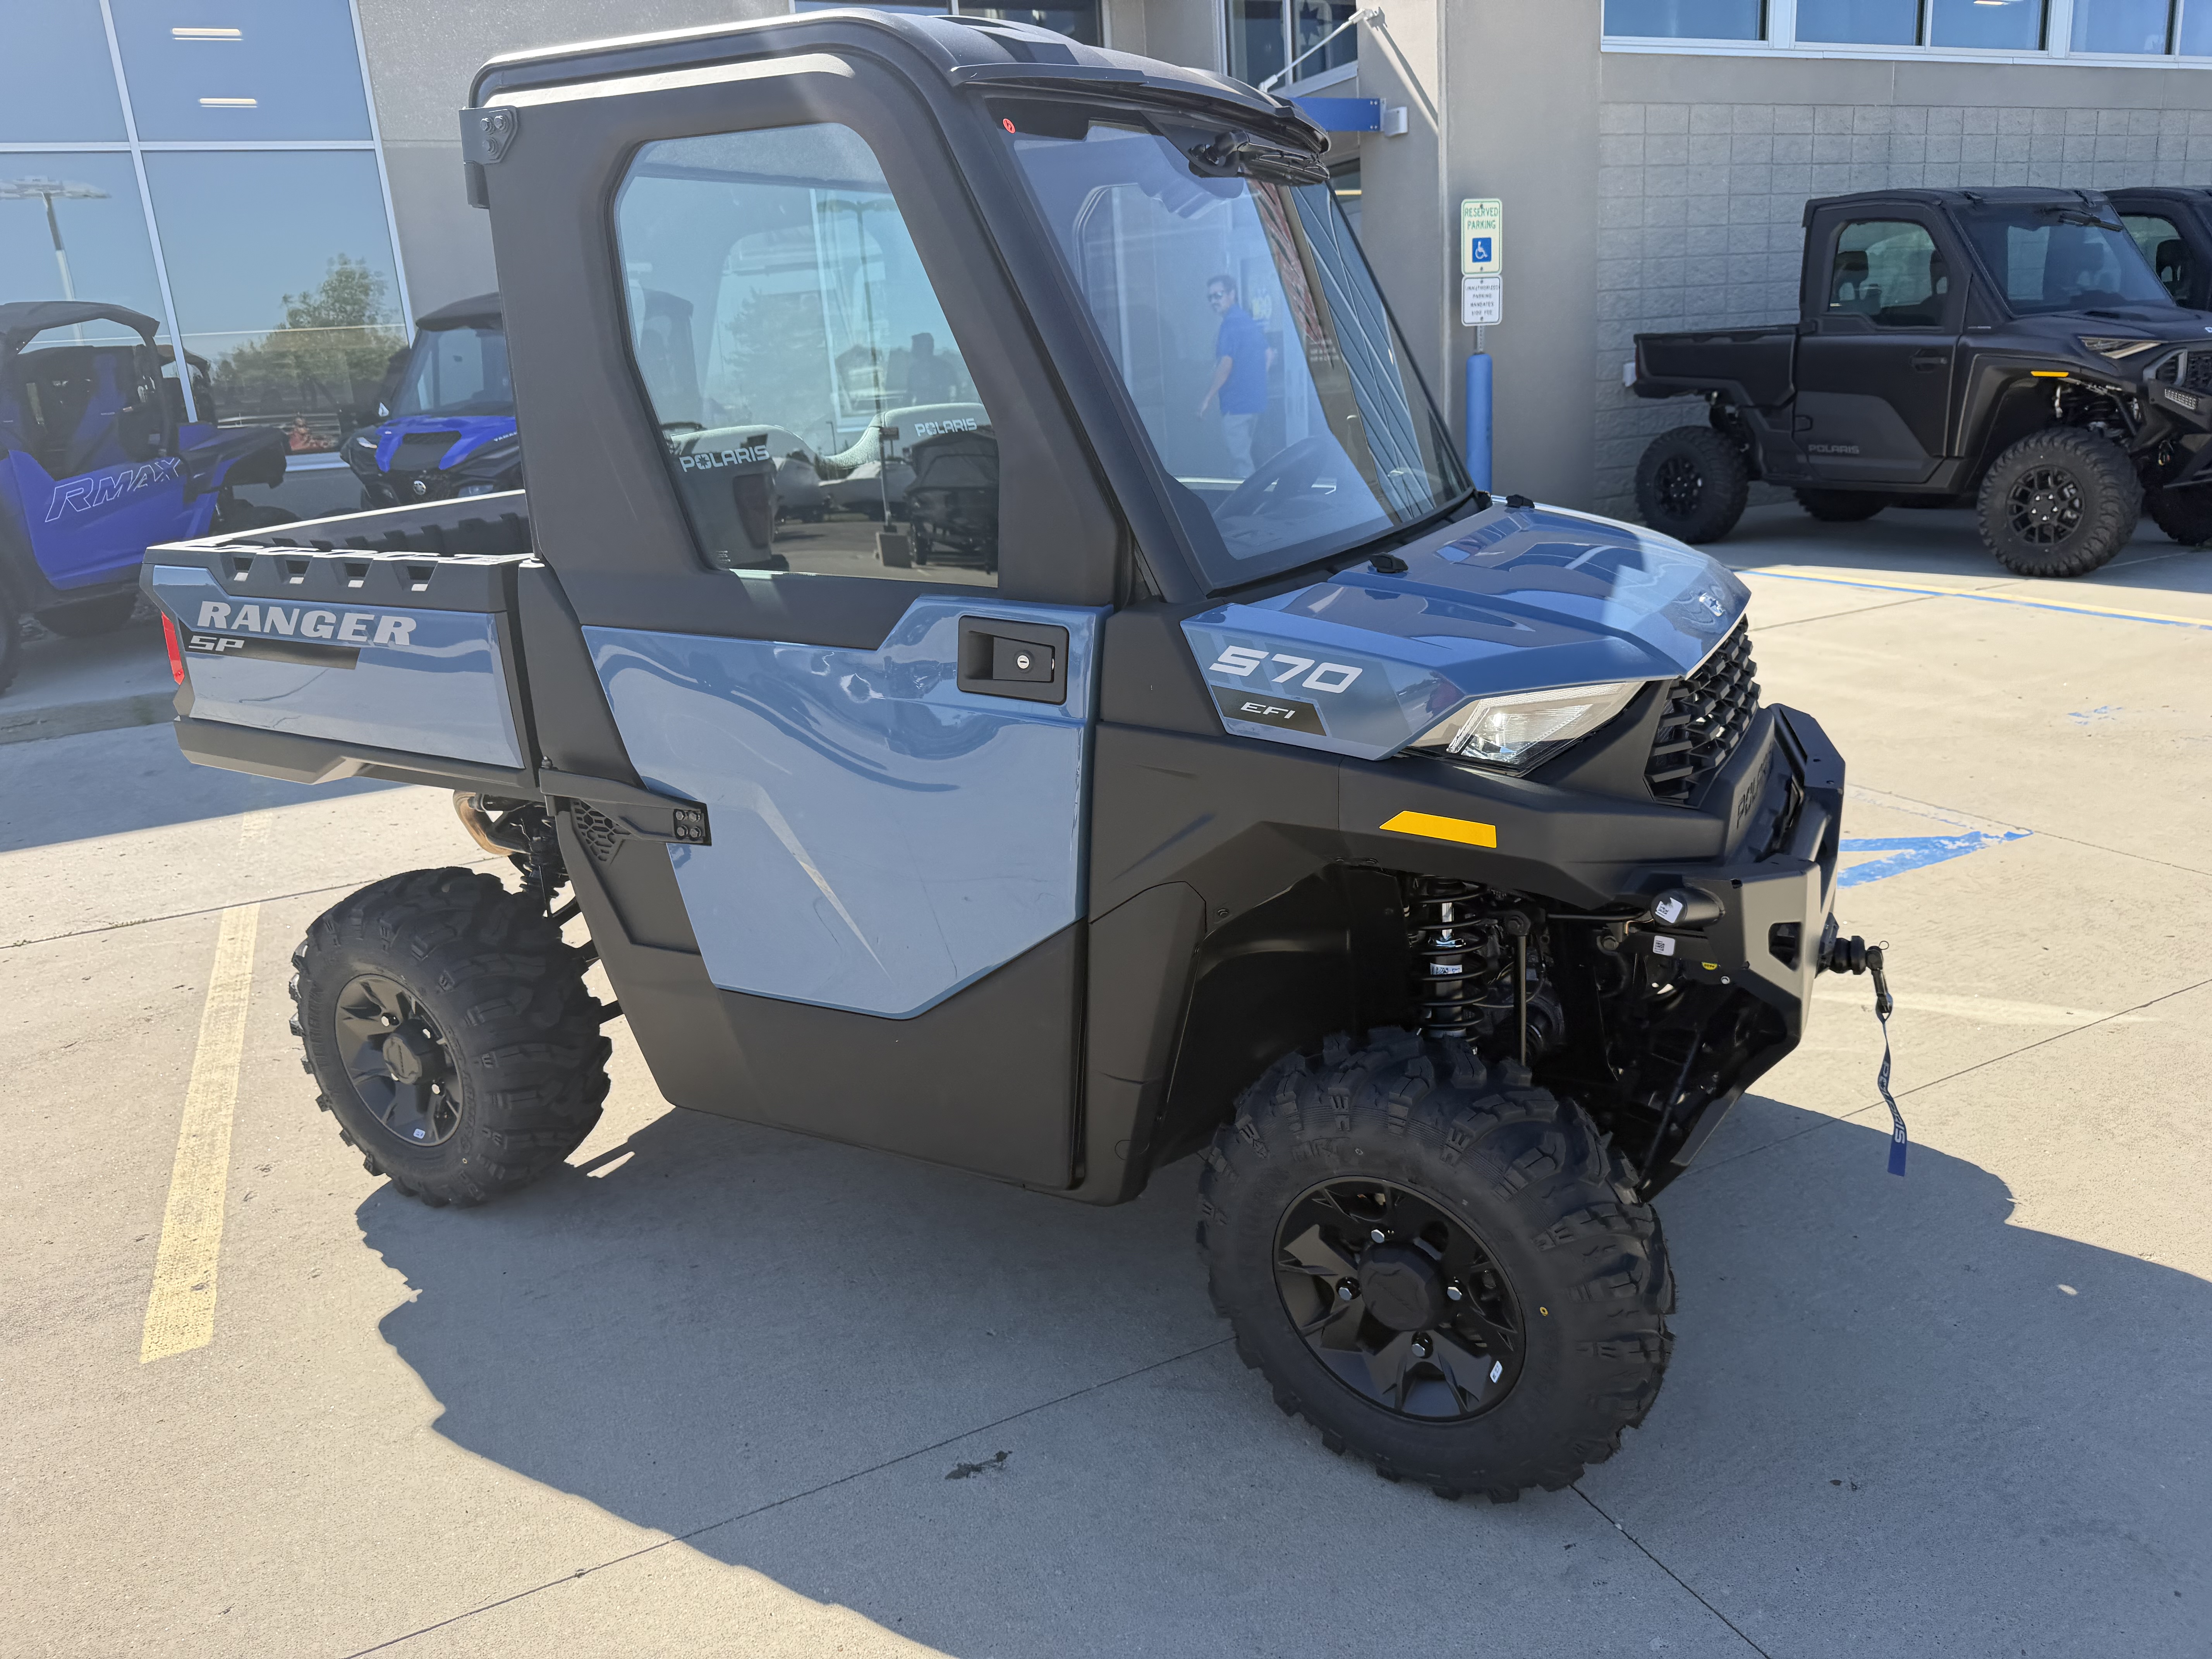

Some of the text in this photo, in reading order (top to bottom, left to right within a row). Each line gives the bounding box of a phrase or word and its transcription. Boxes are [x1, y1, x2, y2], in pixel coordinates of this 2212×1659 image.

[1465, 207, 1498, 217] RESERVED
[1467, 220, 1496, 229] PARKING
[914, 418, 977, 436] POLARIS
[1808, 444, 1860, 454] POLARIS
[679, 445, 770, 472] POLARIS
[45, 457, 180, 522] RMAX
[198, 601, 416, 646] RANGER
[189, 635, 244, 651] SP
[1209, 645, 1363, 694] 570
[1240, 702, 1295, 719] EFI
